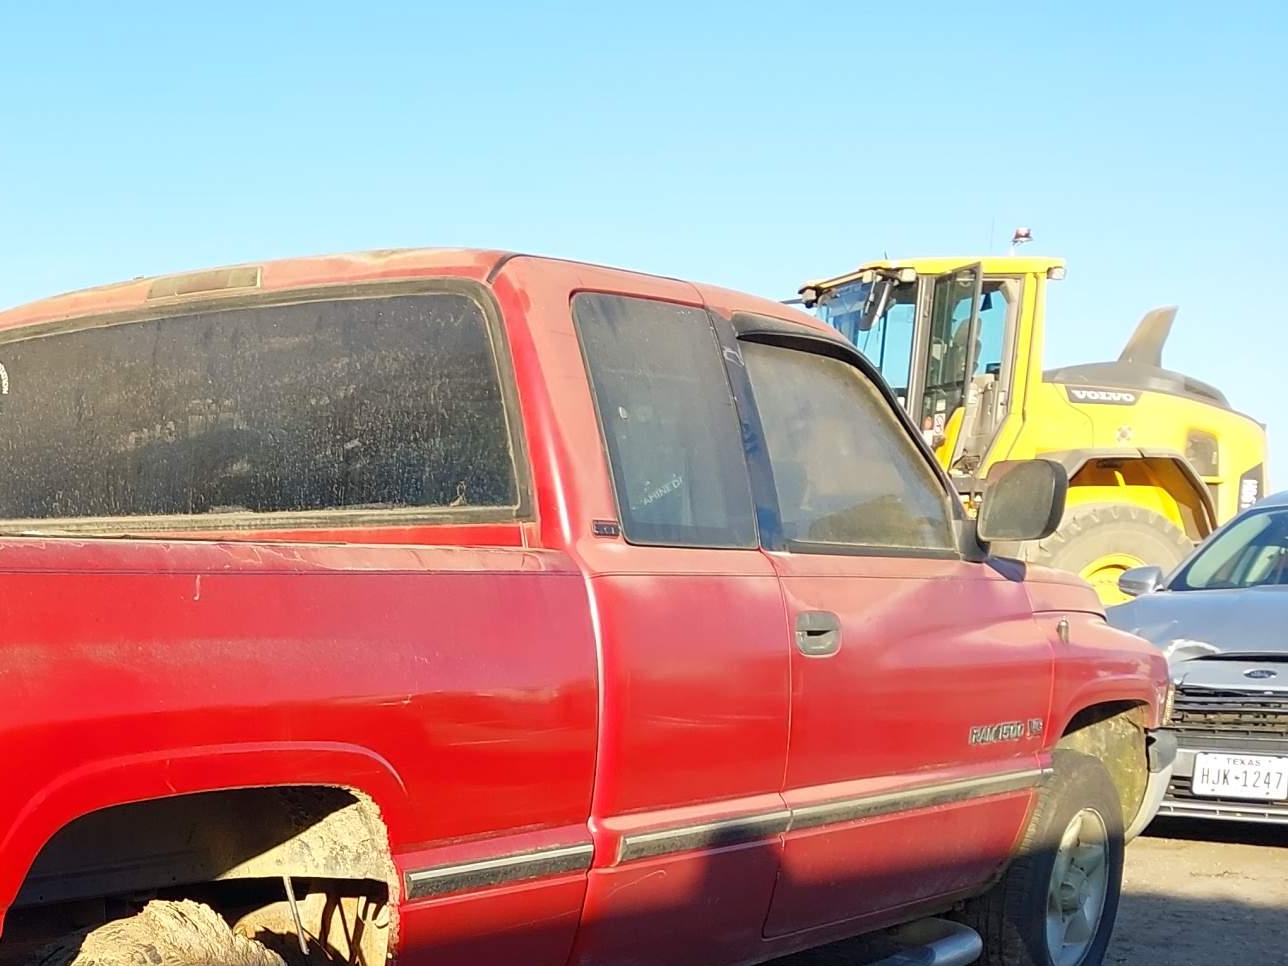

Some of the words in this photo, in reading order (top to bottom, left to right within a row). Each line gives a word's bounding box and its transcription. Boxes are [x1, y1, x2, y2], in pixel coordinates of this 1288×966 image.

[1070, 389, 1136, 402] VOLVO
[971, 726, 995, 744] RAM
[998, 723, 1024, 740] 1500
[1226, 757, 1262, 767] TEXAS
